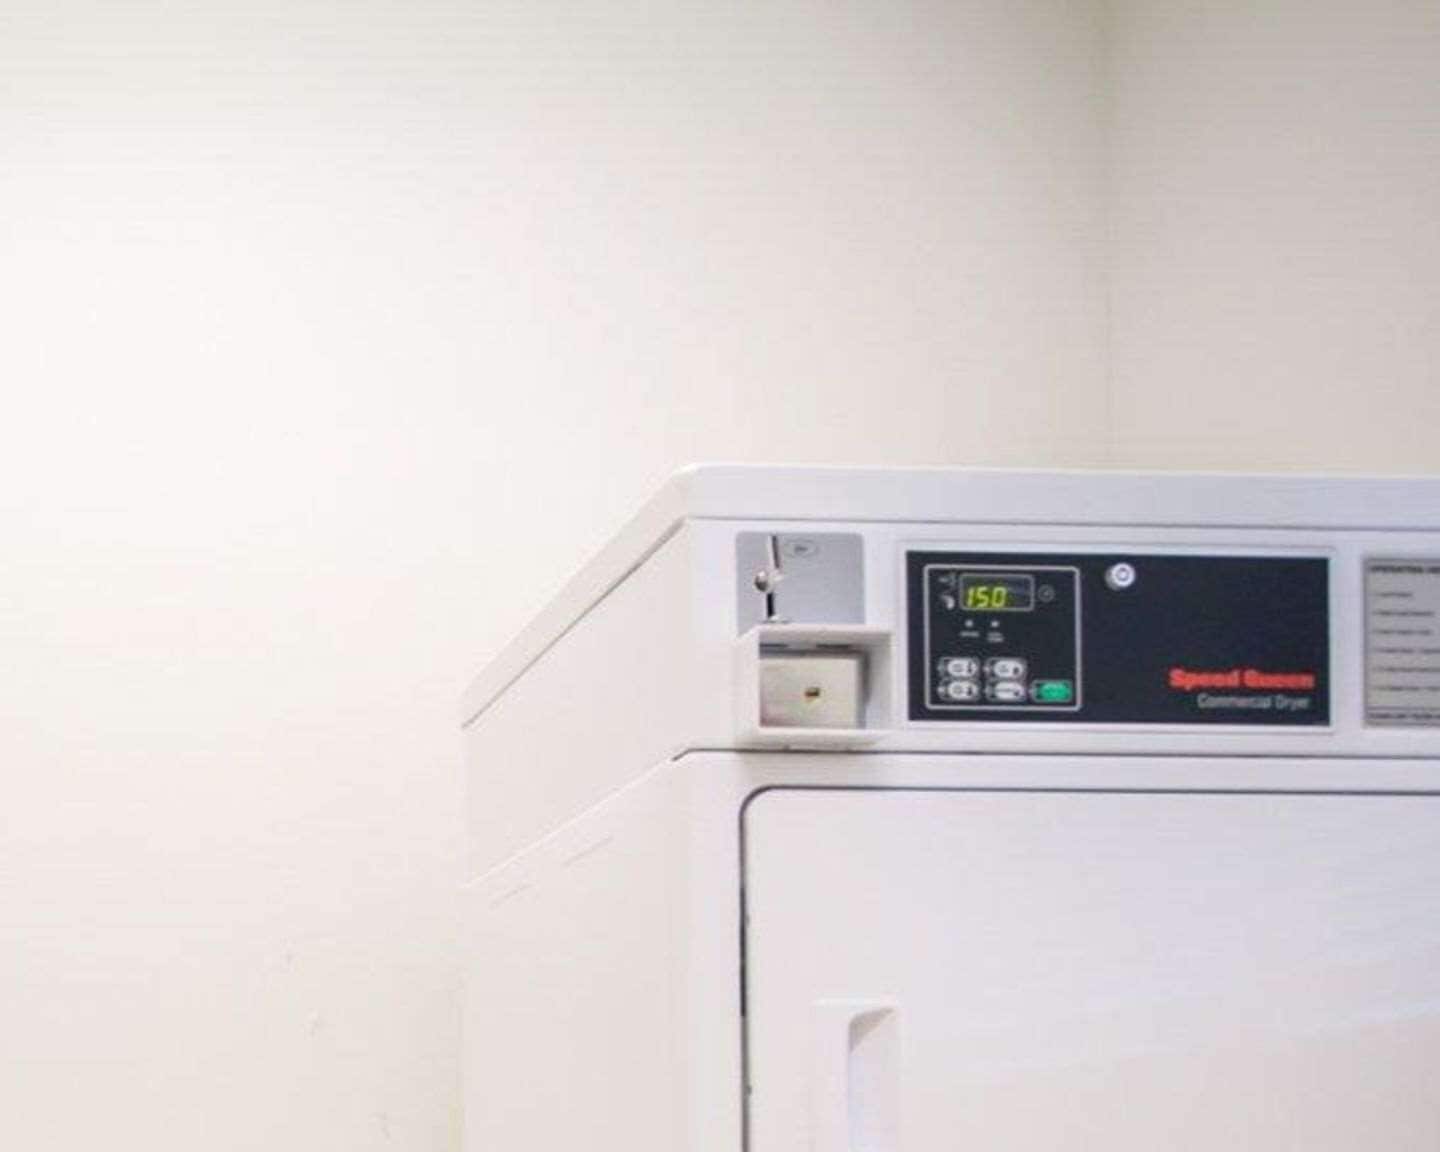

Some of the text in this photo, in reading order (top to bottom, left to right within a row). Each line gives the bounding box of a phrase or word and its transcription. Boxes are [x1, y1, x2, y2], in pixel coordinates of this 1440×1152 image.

[1169, 668, 1316, 691] Speed Queen
[1196, 692, 1310, 711] Commercial Dryer
